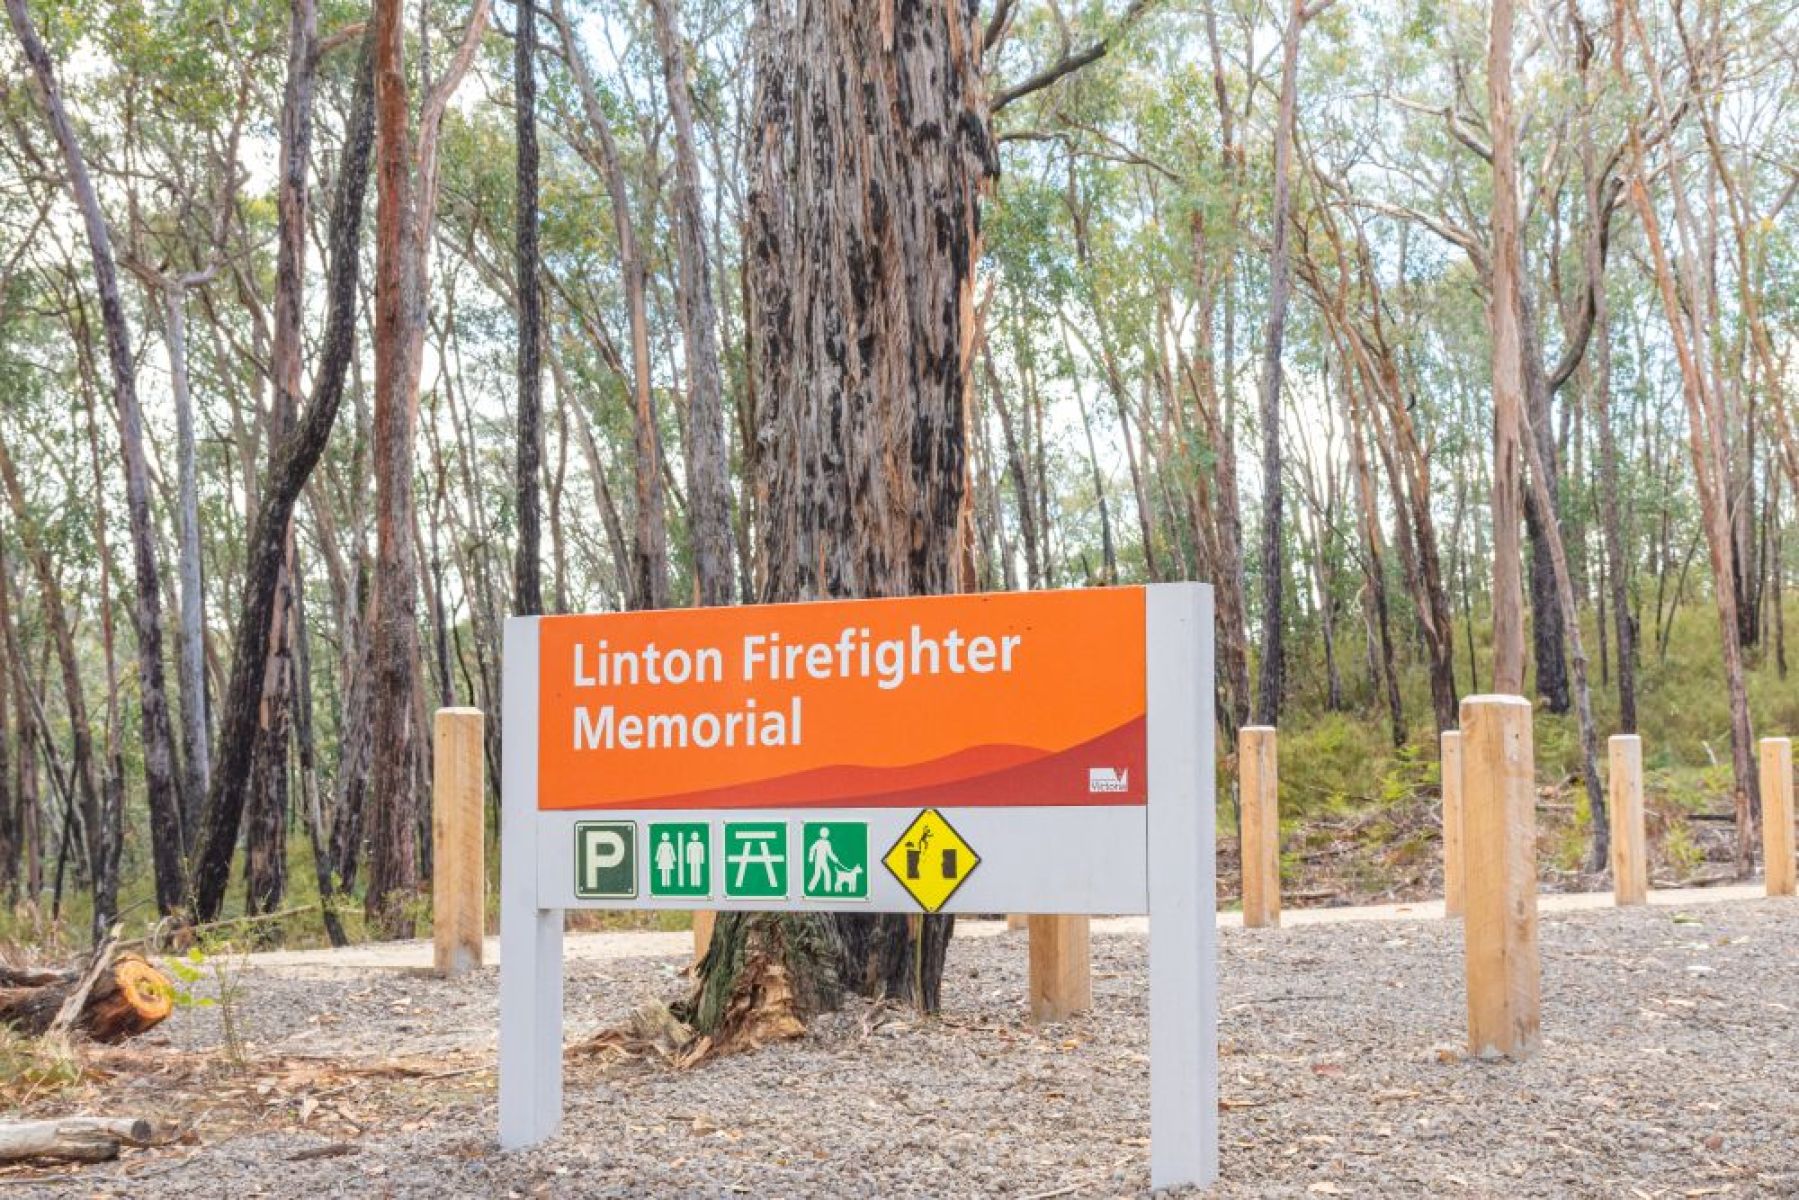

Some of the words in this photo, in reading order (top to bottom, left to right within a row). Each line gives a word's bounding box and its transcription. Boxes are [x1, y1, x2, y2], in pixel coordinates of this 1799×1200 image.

[573, 642, 722, 687] Linton
[743, 625, 1021, 690] Firefighter
[573, 696, 801, 749] Memorial
[586, 830, 625, 888] P
